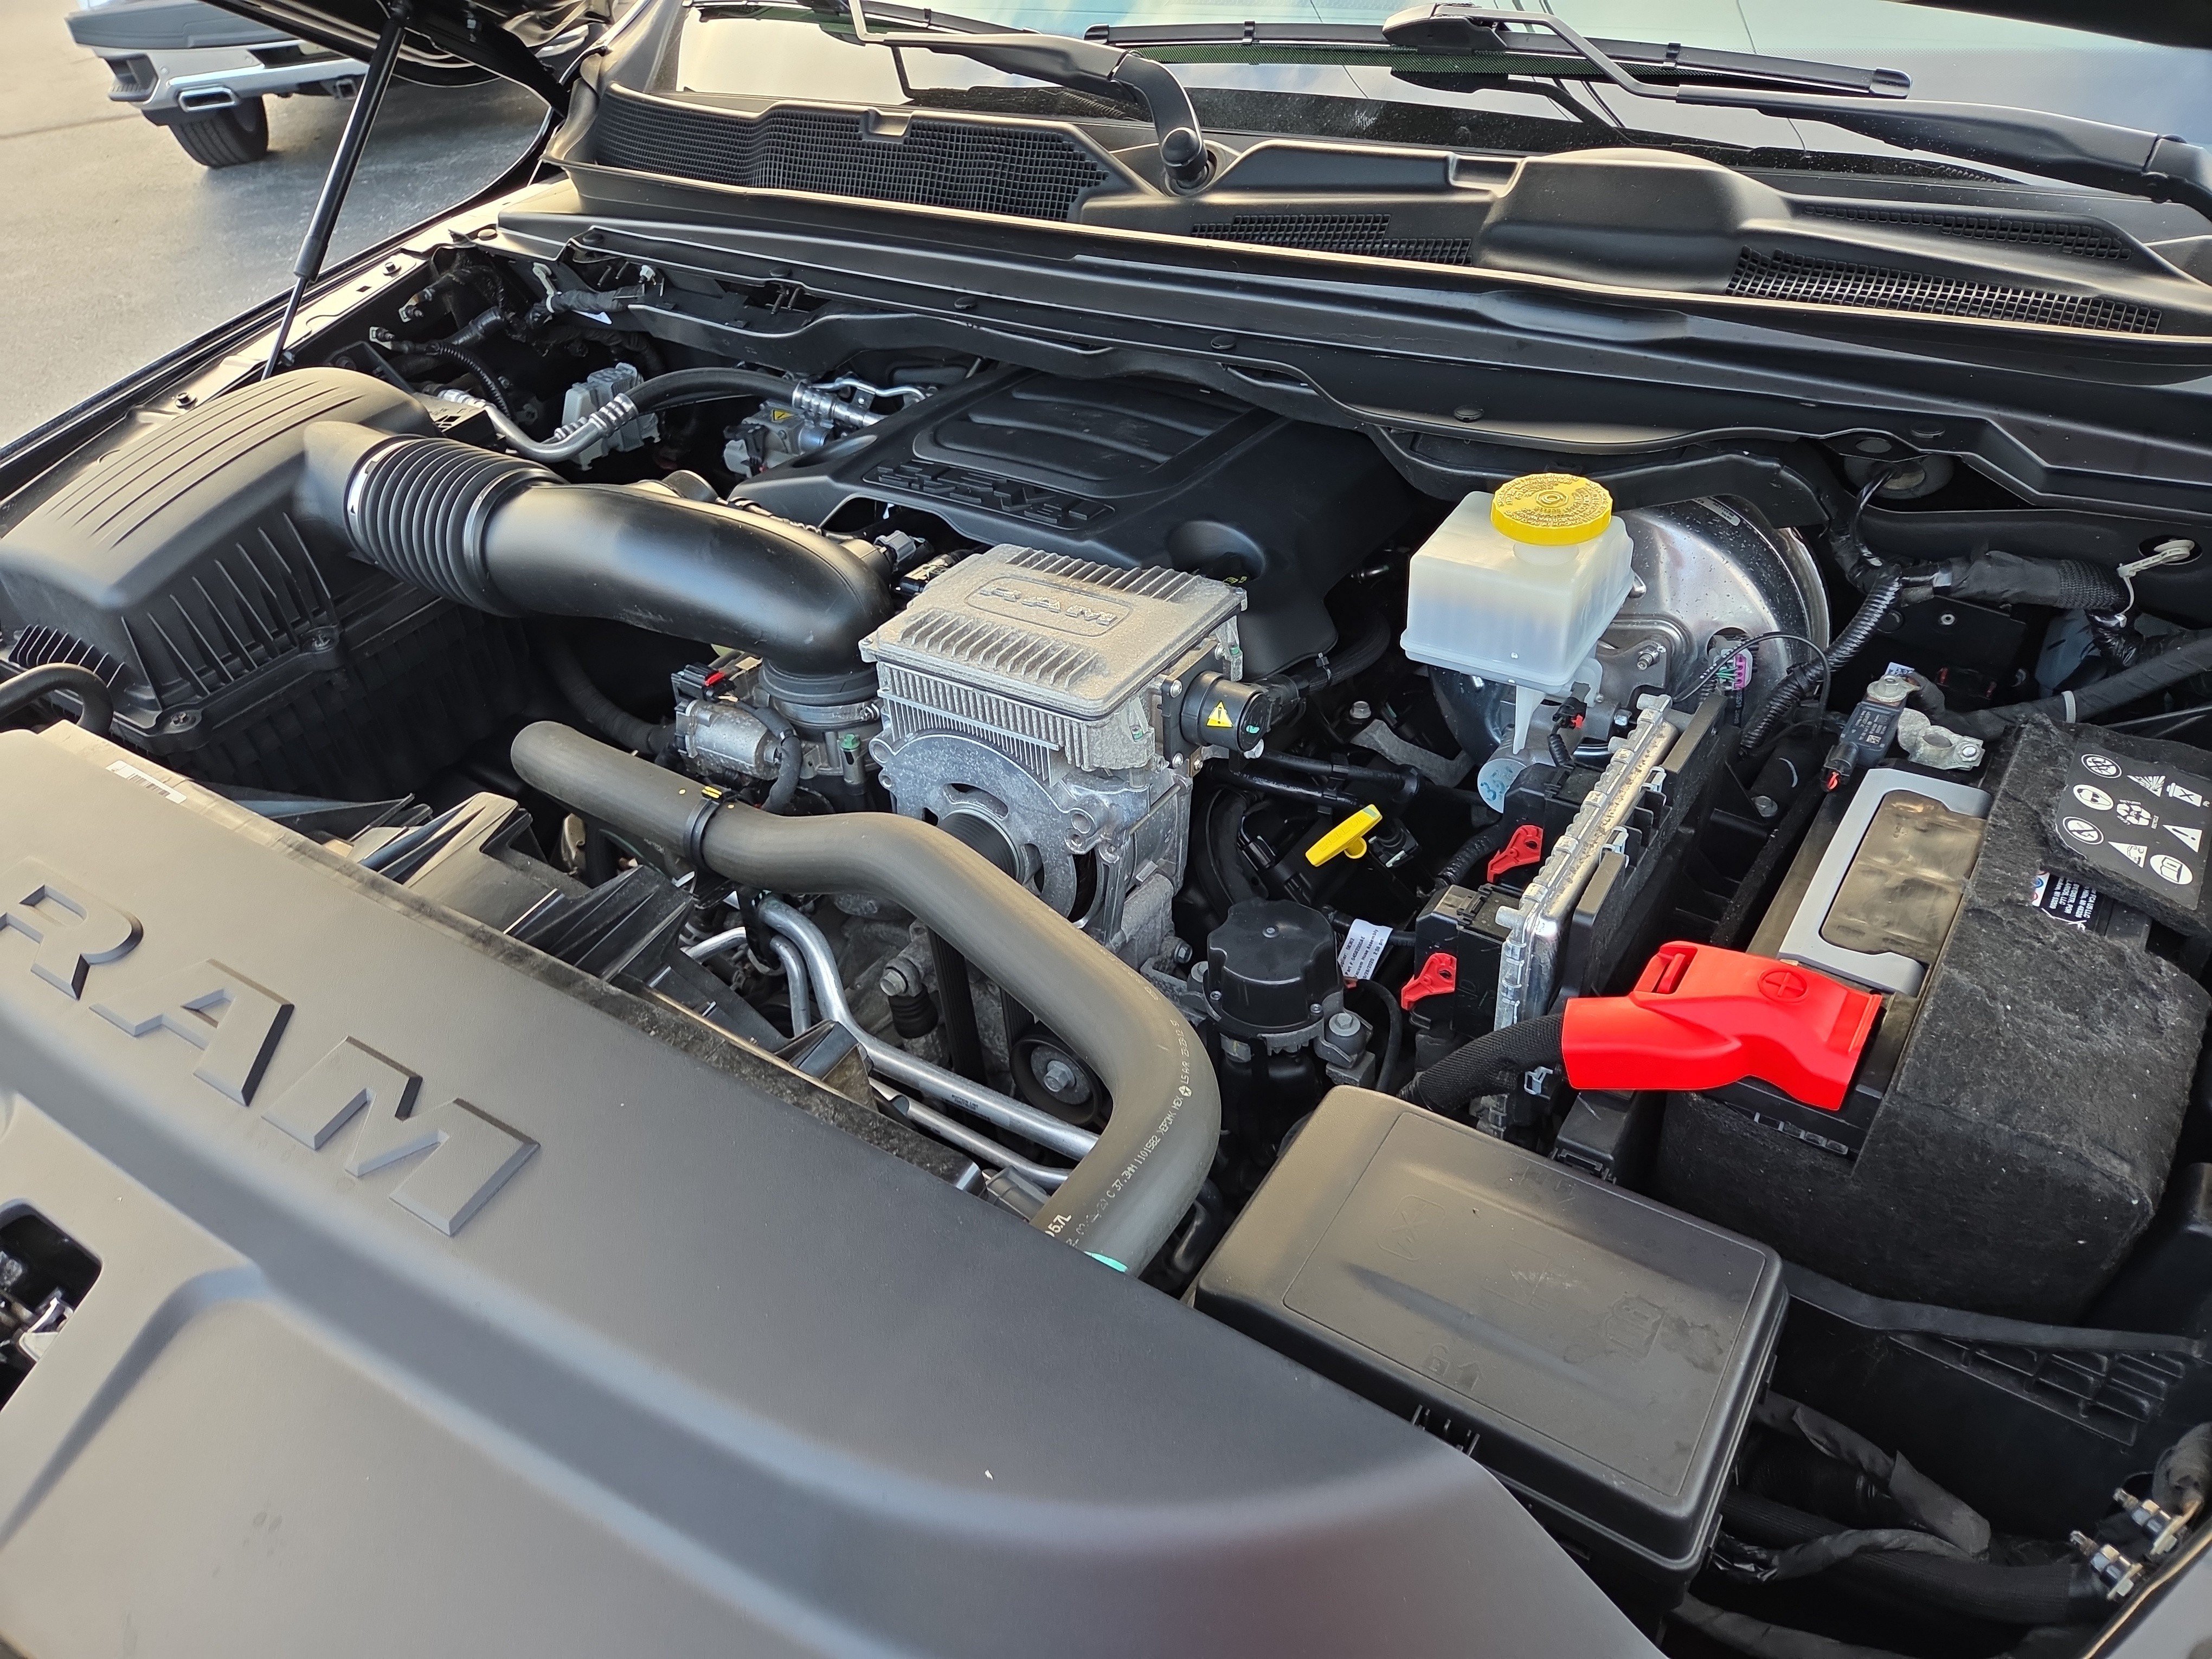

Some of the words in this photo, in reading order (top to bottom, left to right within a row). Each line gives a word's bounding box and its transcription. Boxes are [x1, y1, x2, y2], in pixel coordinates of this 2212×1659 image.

[979, 586, 1118, 626] RAM
[1318, 826, 1351, 852] ENGINE
[2088, 893, 2097, 903] FCA
[0, 856, 541, 1237] RAM
